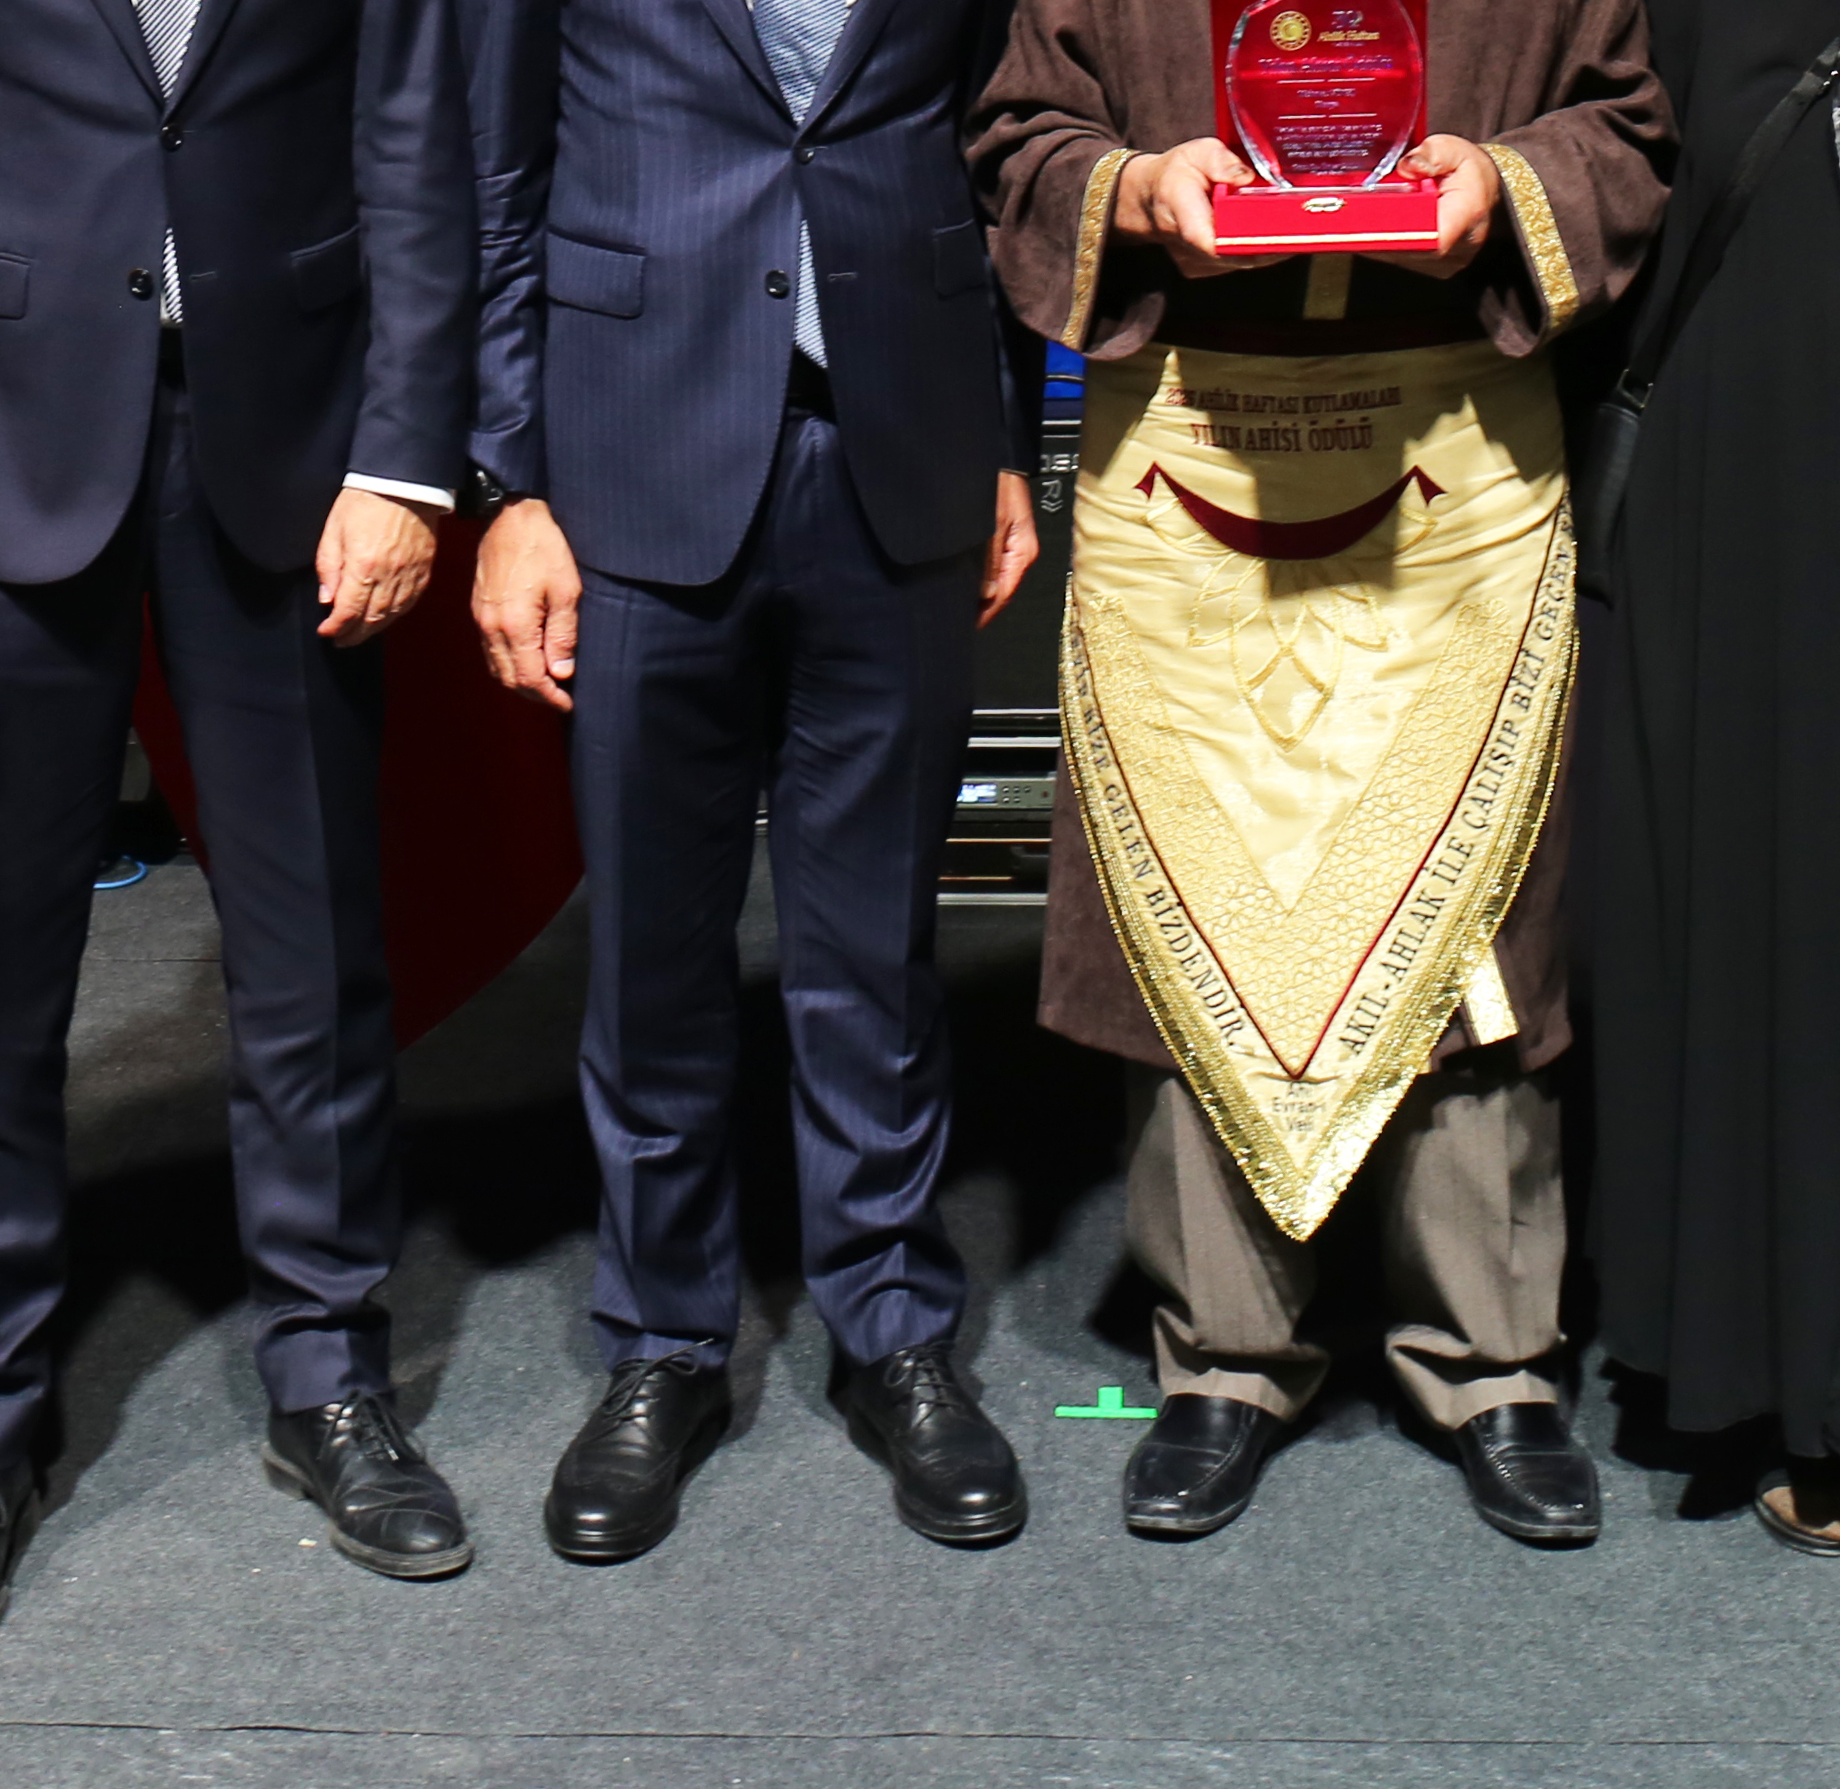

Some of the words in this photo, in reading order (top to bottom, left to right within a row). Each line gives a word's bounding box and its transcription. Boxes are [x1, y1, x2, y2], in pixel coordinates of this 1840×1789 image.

[1190, 423, 1241, 449] YILIN
[1244, 420, 1303, 452] AHİSİ
[1307, 416, 1373, 452] ÖDÜLÜ
[1423, 836, 1476, 886] İLE
[1462, 718, 1522, 831] ÇALIŞIP
[1511, 647, 1544, 712] BİZİ
[1103, 782, 1156, 882] GELEN
